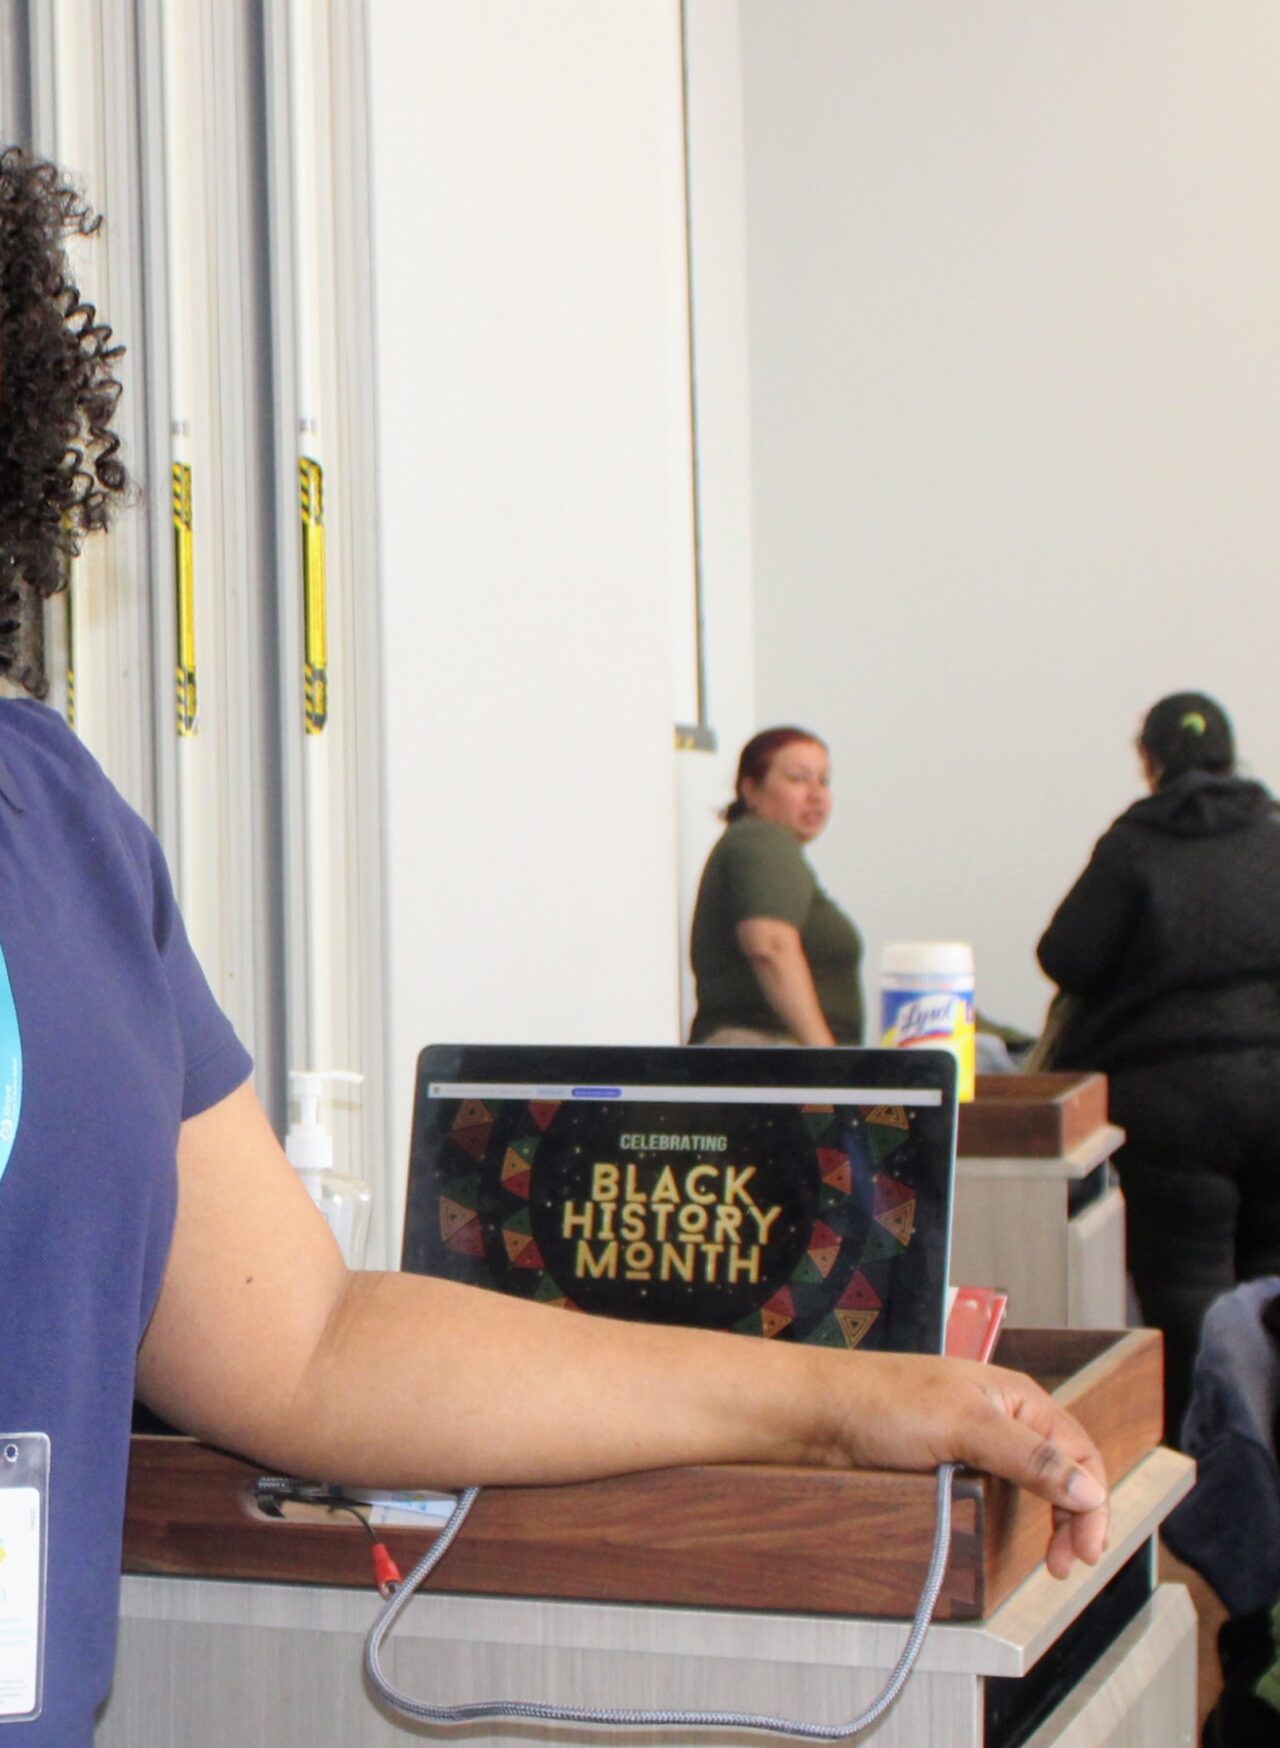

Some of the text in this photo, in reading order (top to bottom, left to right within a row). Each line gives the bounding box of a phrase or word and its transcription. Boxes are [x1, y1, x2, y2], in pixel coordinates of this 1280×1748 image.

[620, 1133, 728, 1151] CELEBRATING
[591, 1162, 757, 1205] BLACK
[562, 1201, 782, 1245] HISTORY
[575, 1240, 760, 1284] MONTH
